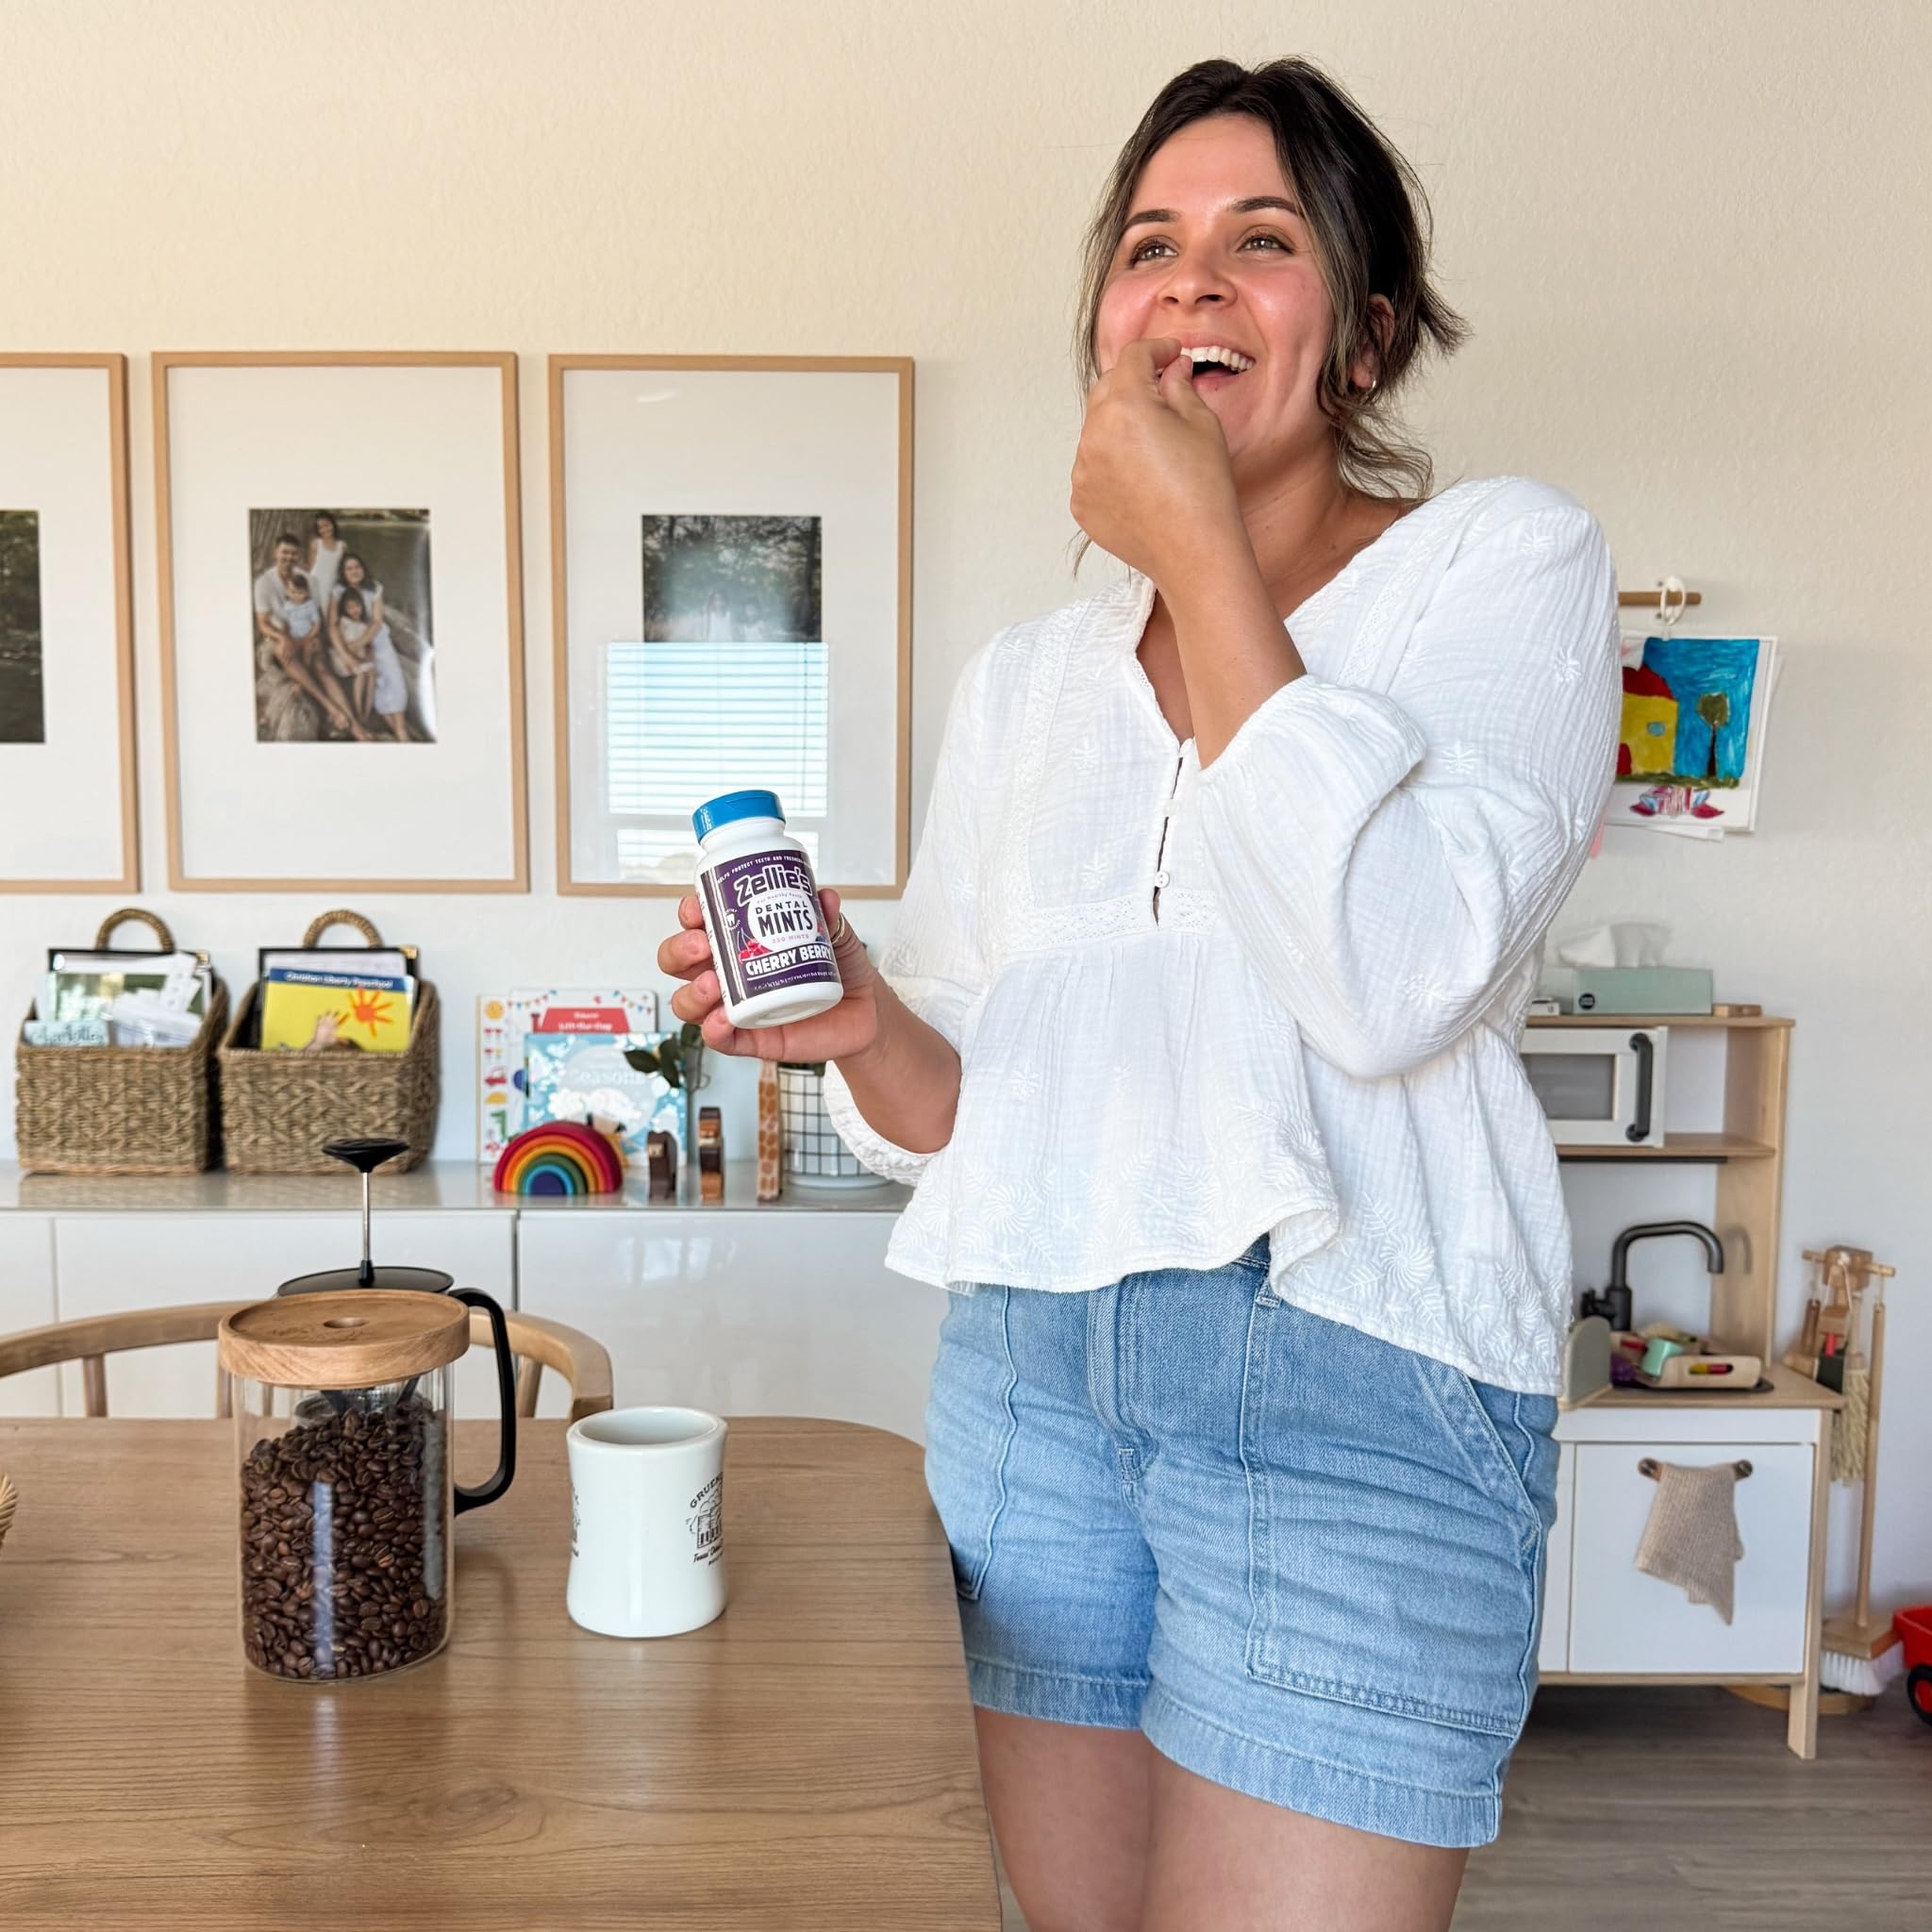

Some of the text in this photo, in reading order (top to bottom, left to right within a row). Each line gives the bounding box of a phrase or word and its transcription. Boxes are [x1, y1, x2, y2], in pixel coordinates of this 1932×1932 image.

[732, 860, 754, 874] PROTECT
[734, 864, 812, 907] Zellie's
[756, 901, 808, 914] DENTAL
[758, 909, 813, 937] MINTS
[745, 944, 832, 975] CHERRY BERRY
